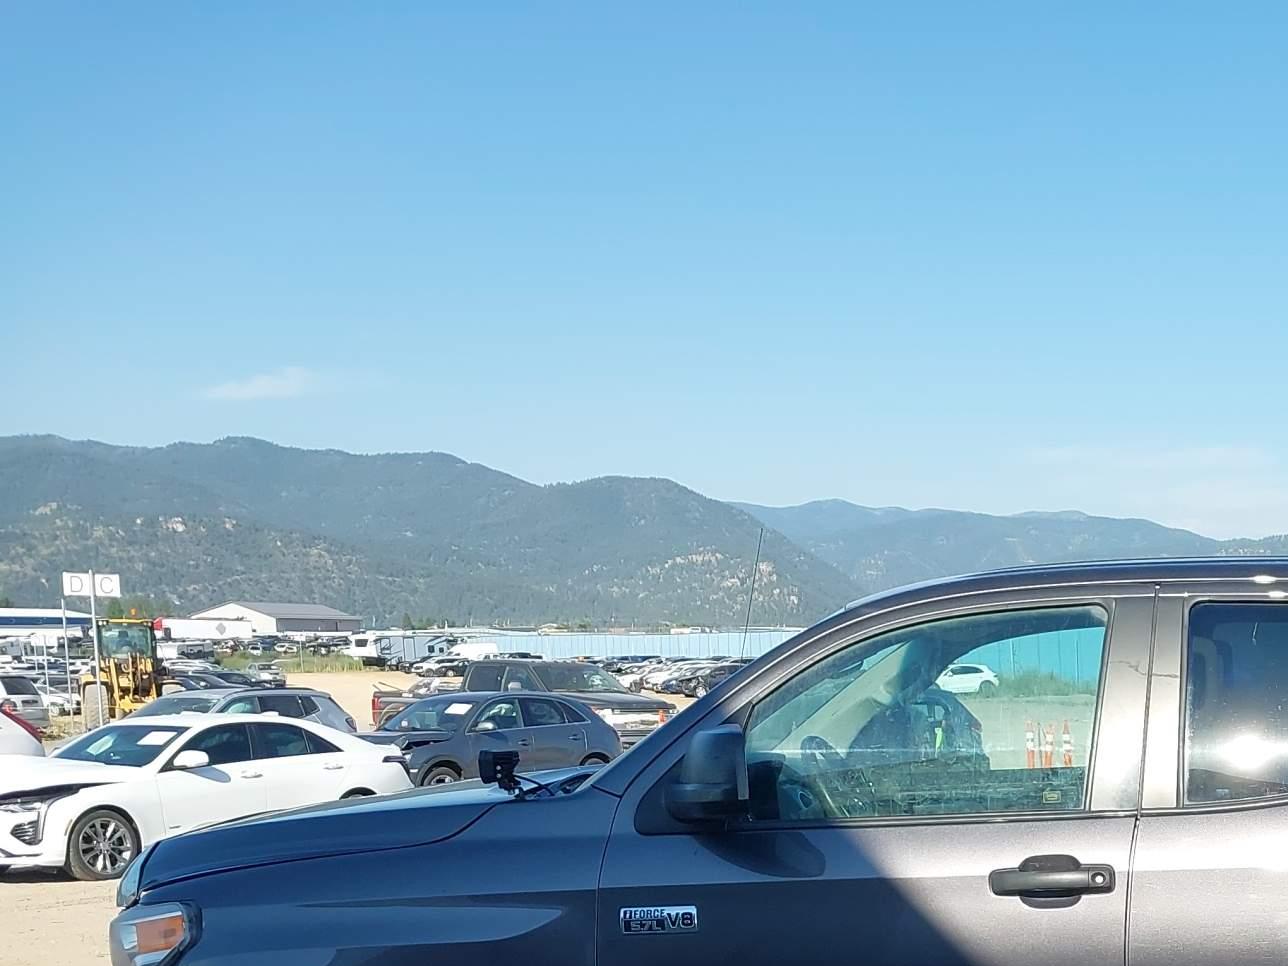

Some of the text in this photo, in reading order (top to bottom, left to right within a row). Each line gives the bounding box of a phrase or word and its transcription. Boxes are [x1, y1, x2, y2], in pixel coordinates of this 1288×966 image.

[70, 575, 113, 594] D C
[666, 911, 696, 929] V8
